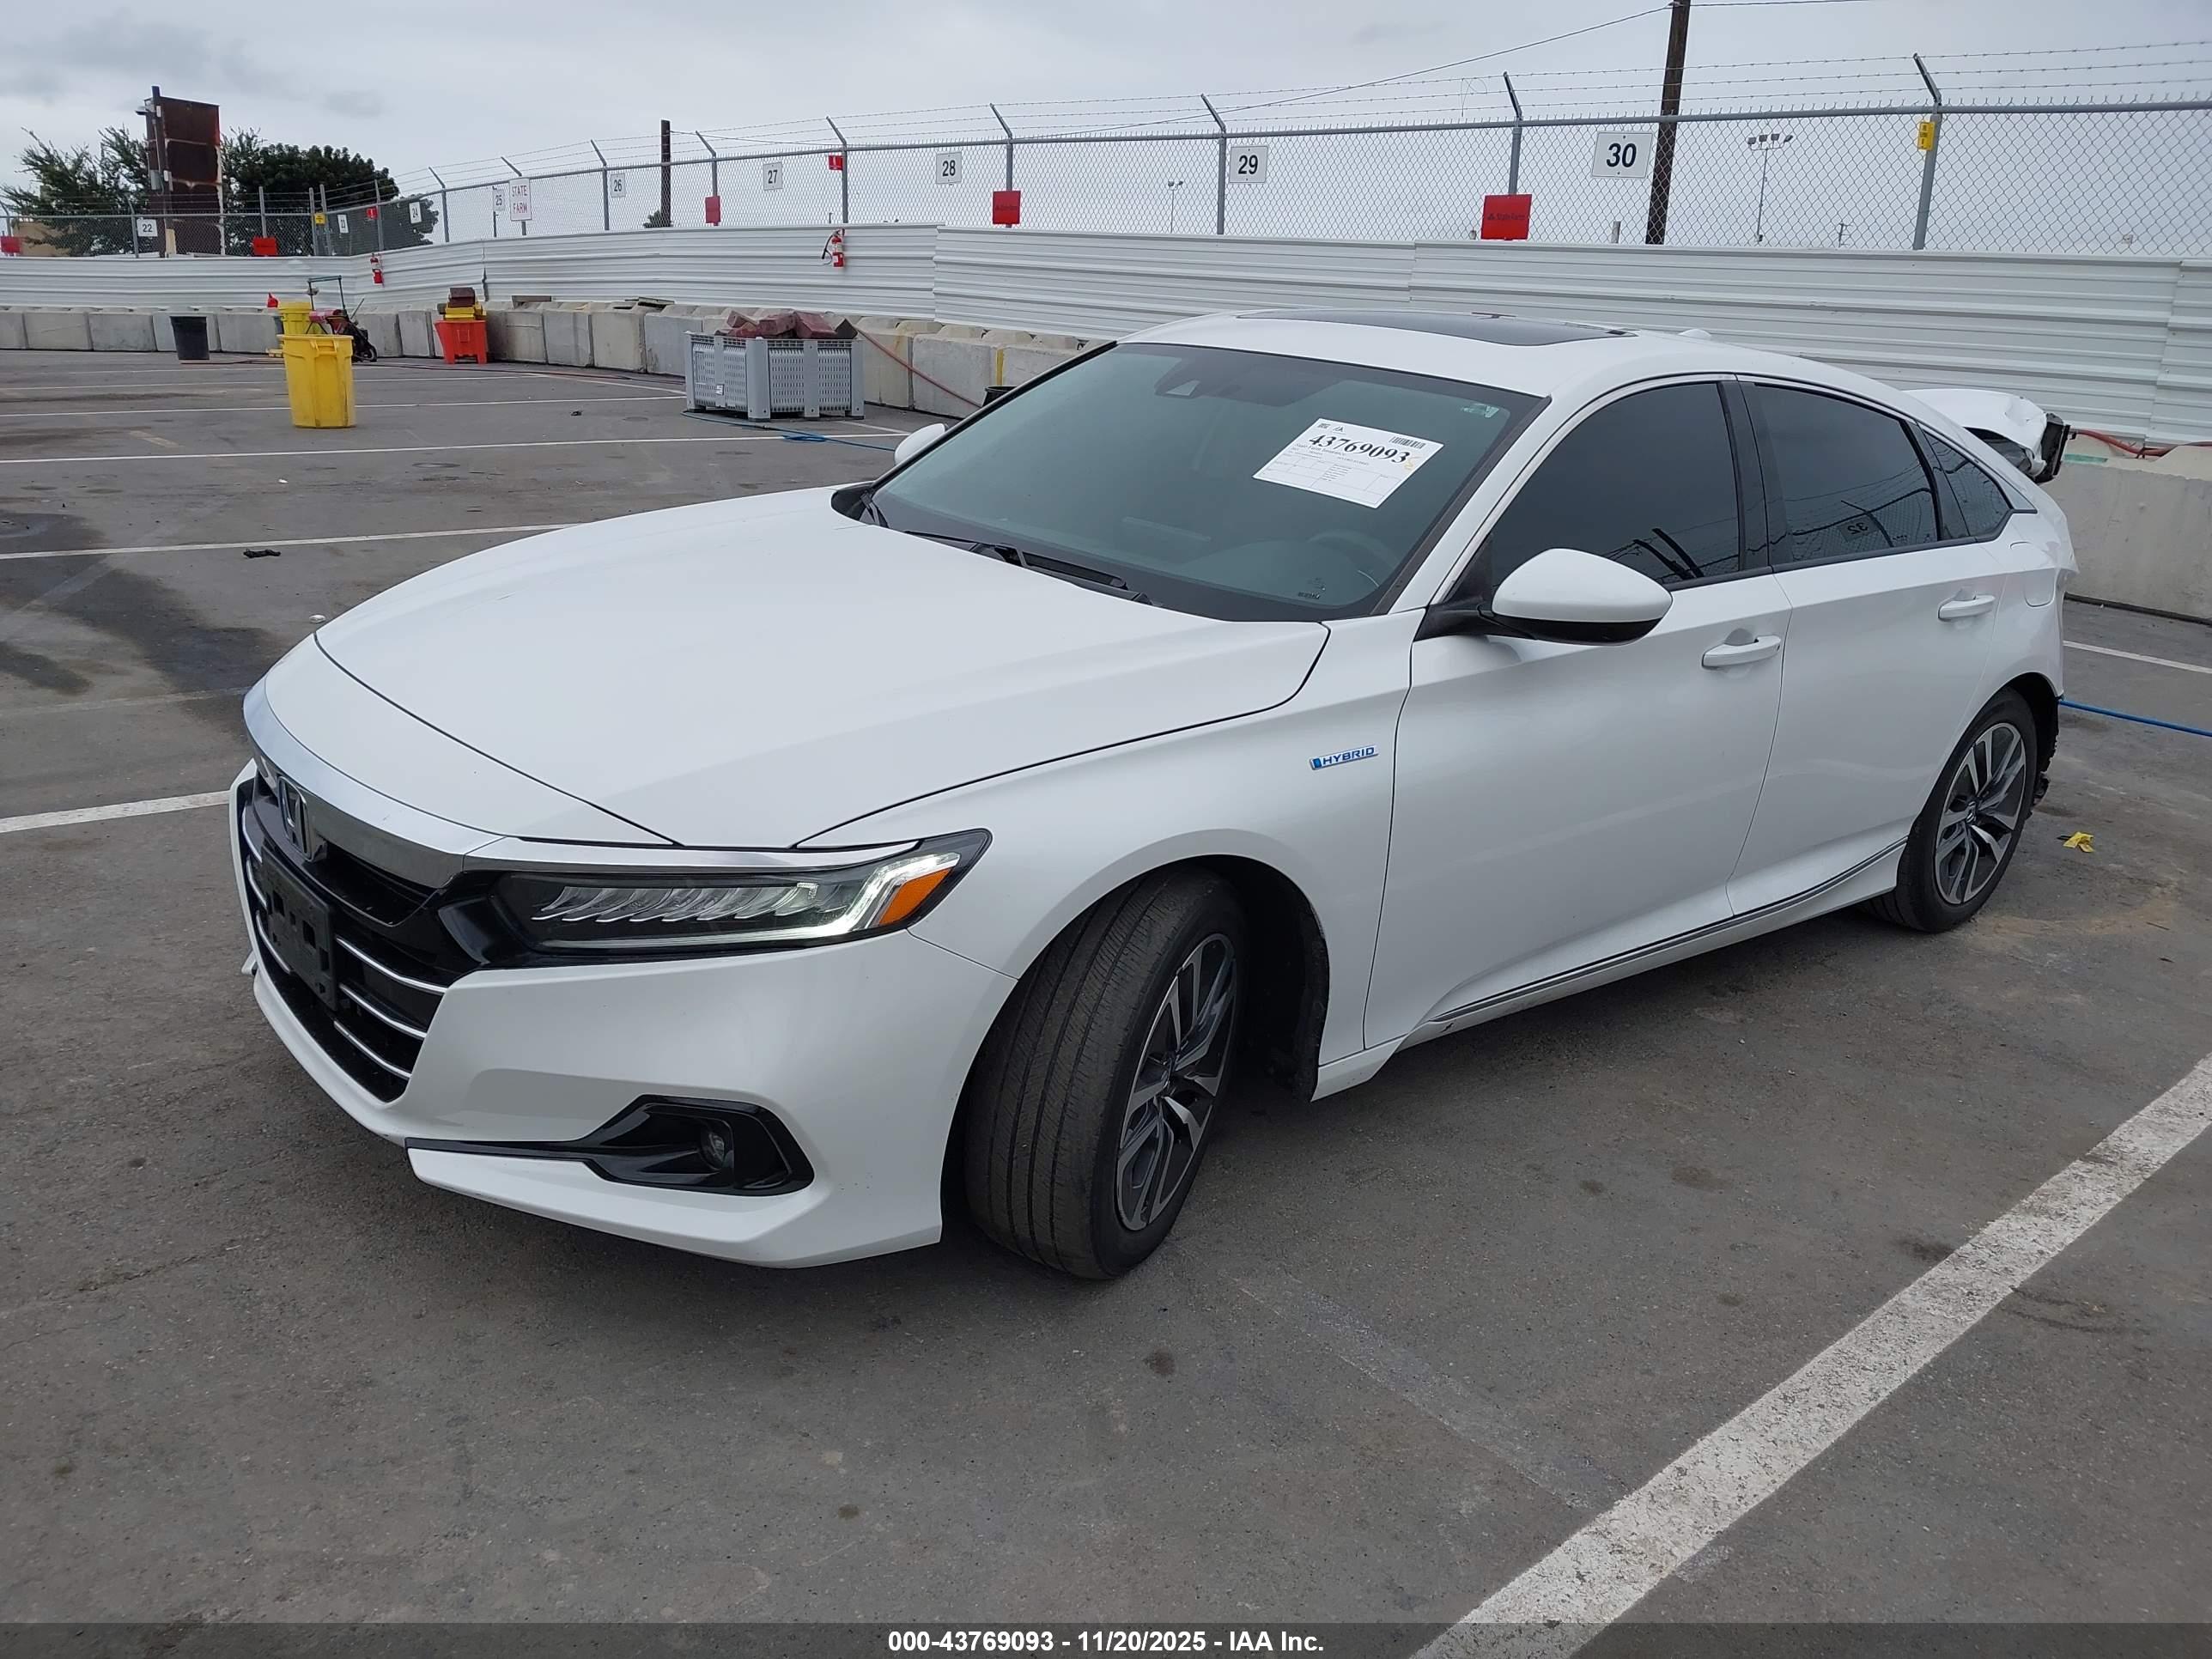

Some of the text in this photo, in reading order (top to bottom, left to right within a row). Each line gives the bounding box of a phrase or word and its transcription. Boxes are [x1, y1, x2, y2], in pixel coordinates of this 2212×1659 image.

[1606, 143, 1637, 167] 30
[942, 160, 956, 177] 28
[1238, 155, 1258, 175] 29
[768, 169, 778, 184] 27
[512, 185, 528, 197] STATE
[613, 179, 623, 192] 26
[495, 194, 503, 206] 25
[411, 207, 419, 218] 24
[513, 202, 528, 214] FARM
[142, 223, 153, 233] 22
[1308, 434, 1411, 463] 43769093
[1323, 746, 1375, 765] HYBRID
